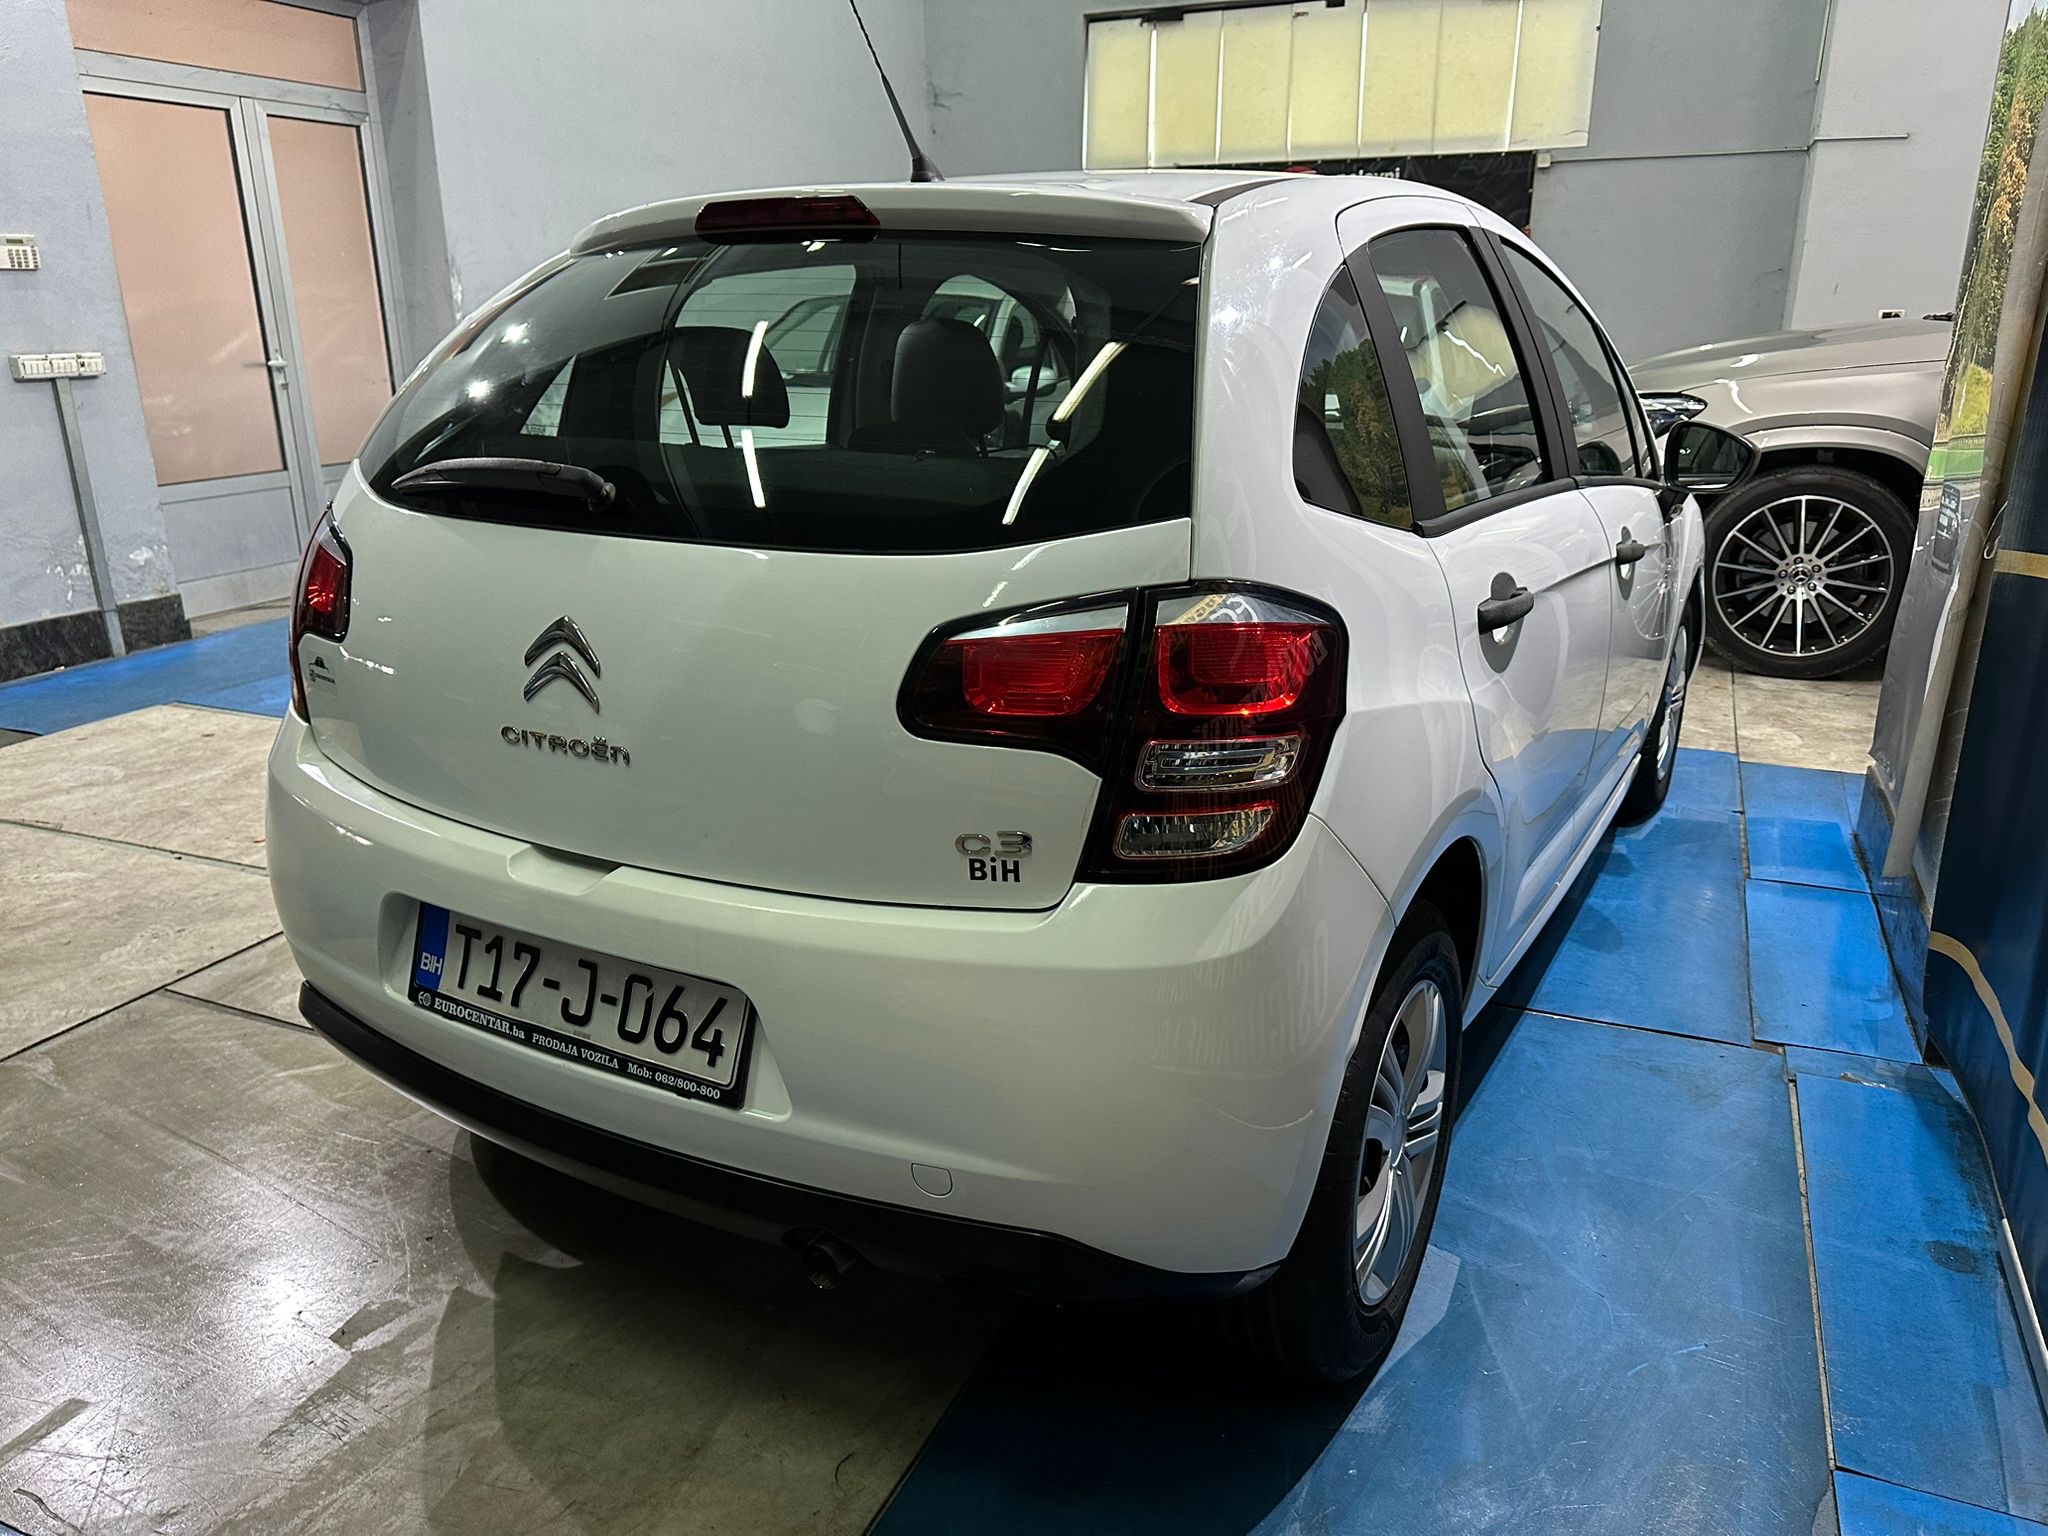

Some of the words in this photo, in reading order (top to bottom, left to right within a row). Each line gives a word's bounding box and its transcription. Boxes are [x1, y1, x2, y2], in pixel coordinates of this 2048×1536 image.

[955, 830, 1032, 857] C3
[968, 856, 1021, 883] BiH
[455, 924, 728, 1067] T17-J-064
[434, 997, 525, 1039] EUROCENTAR.ba
[532, 1033, 579, 1056] PRODAJA
[581, 1048, 619, 1069] VOZILA
[627, 1062, 653, 1079] Mob:
[655, 1071, 721, 1100] 062/800-800
